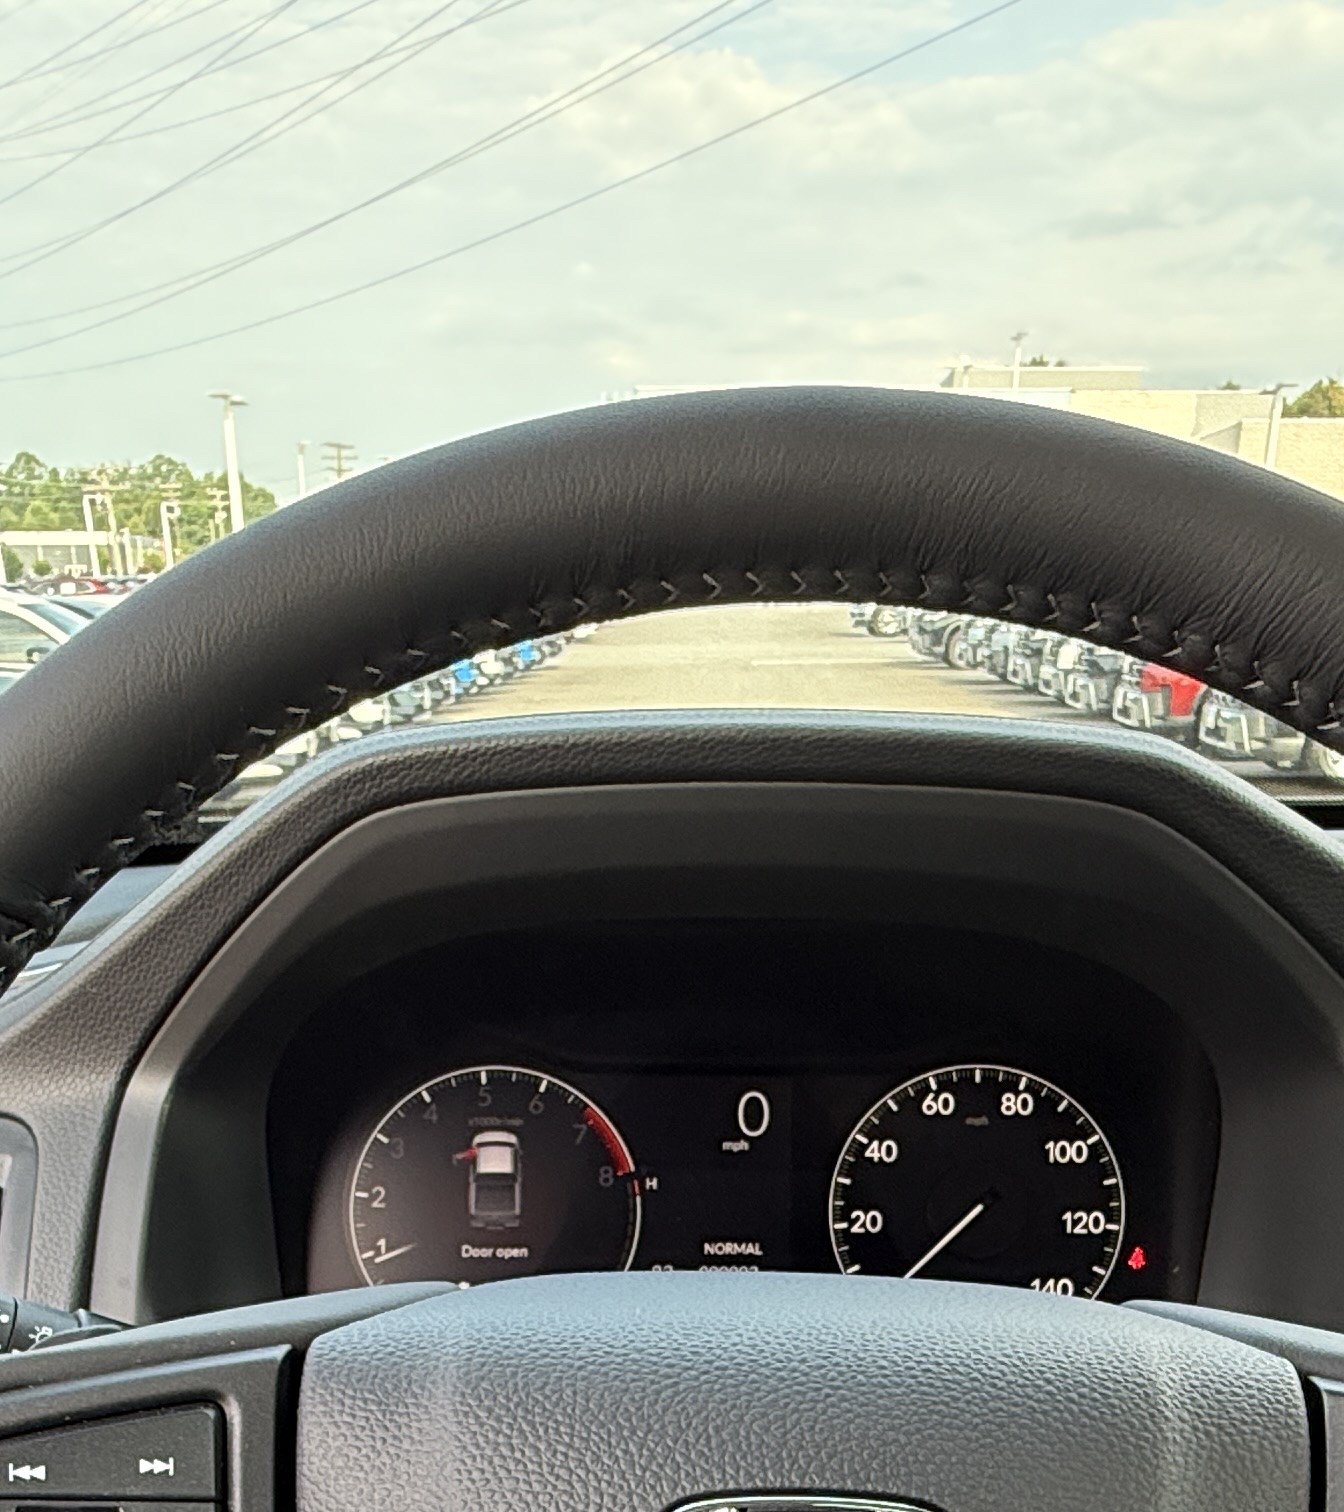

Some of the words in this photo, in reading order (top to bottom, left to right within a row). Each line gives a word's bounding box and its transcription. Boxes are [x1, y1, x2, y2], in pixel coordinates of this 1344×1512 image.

[478, 1087, 492, 1107] 5
[529, 1093, 544, 1115] 6
[921, 1093, 955, 1116] 60
[1000, 1092, 1035, 1116] 80
[423, 1104, 439, 1123] 4
[738, 1091, 770, 1137] 0
[573, 1124, 588, 1144] 7
[389, 1138, 405, 1160] 3
[721, 1139, 750, 1152] mph
[864, 1139, 899, 1163] 40
[1044, 1140, 1090, 1164] 100
[599, 1166, 614, 1188] 8
[645, 1177, 658, 1191] H
[371, 1186, 386, 1209] 2
[850, 1210, 883, 1233] 20
[1062, 1211, 1106, 1235] 120
[377, 1239, 387, 1254] 1
[461, 1244, 494, 1259] Door
[496, 1247, 528, 1261] open
[703, 1242, 763, 1256] NORMAL
